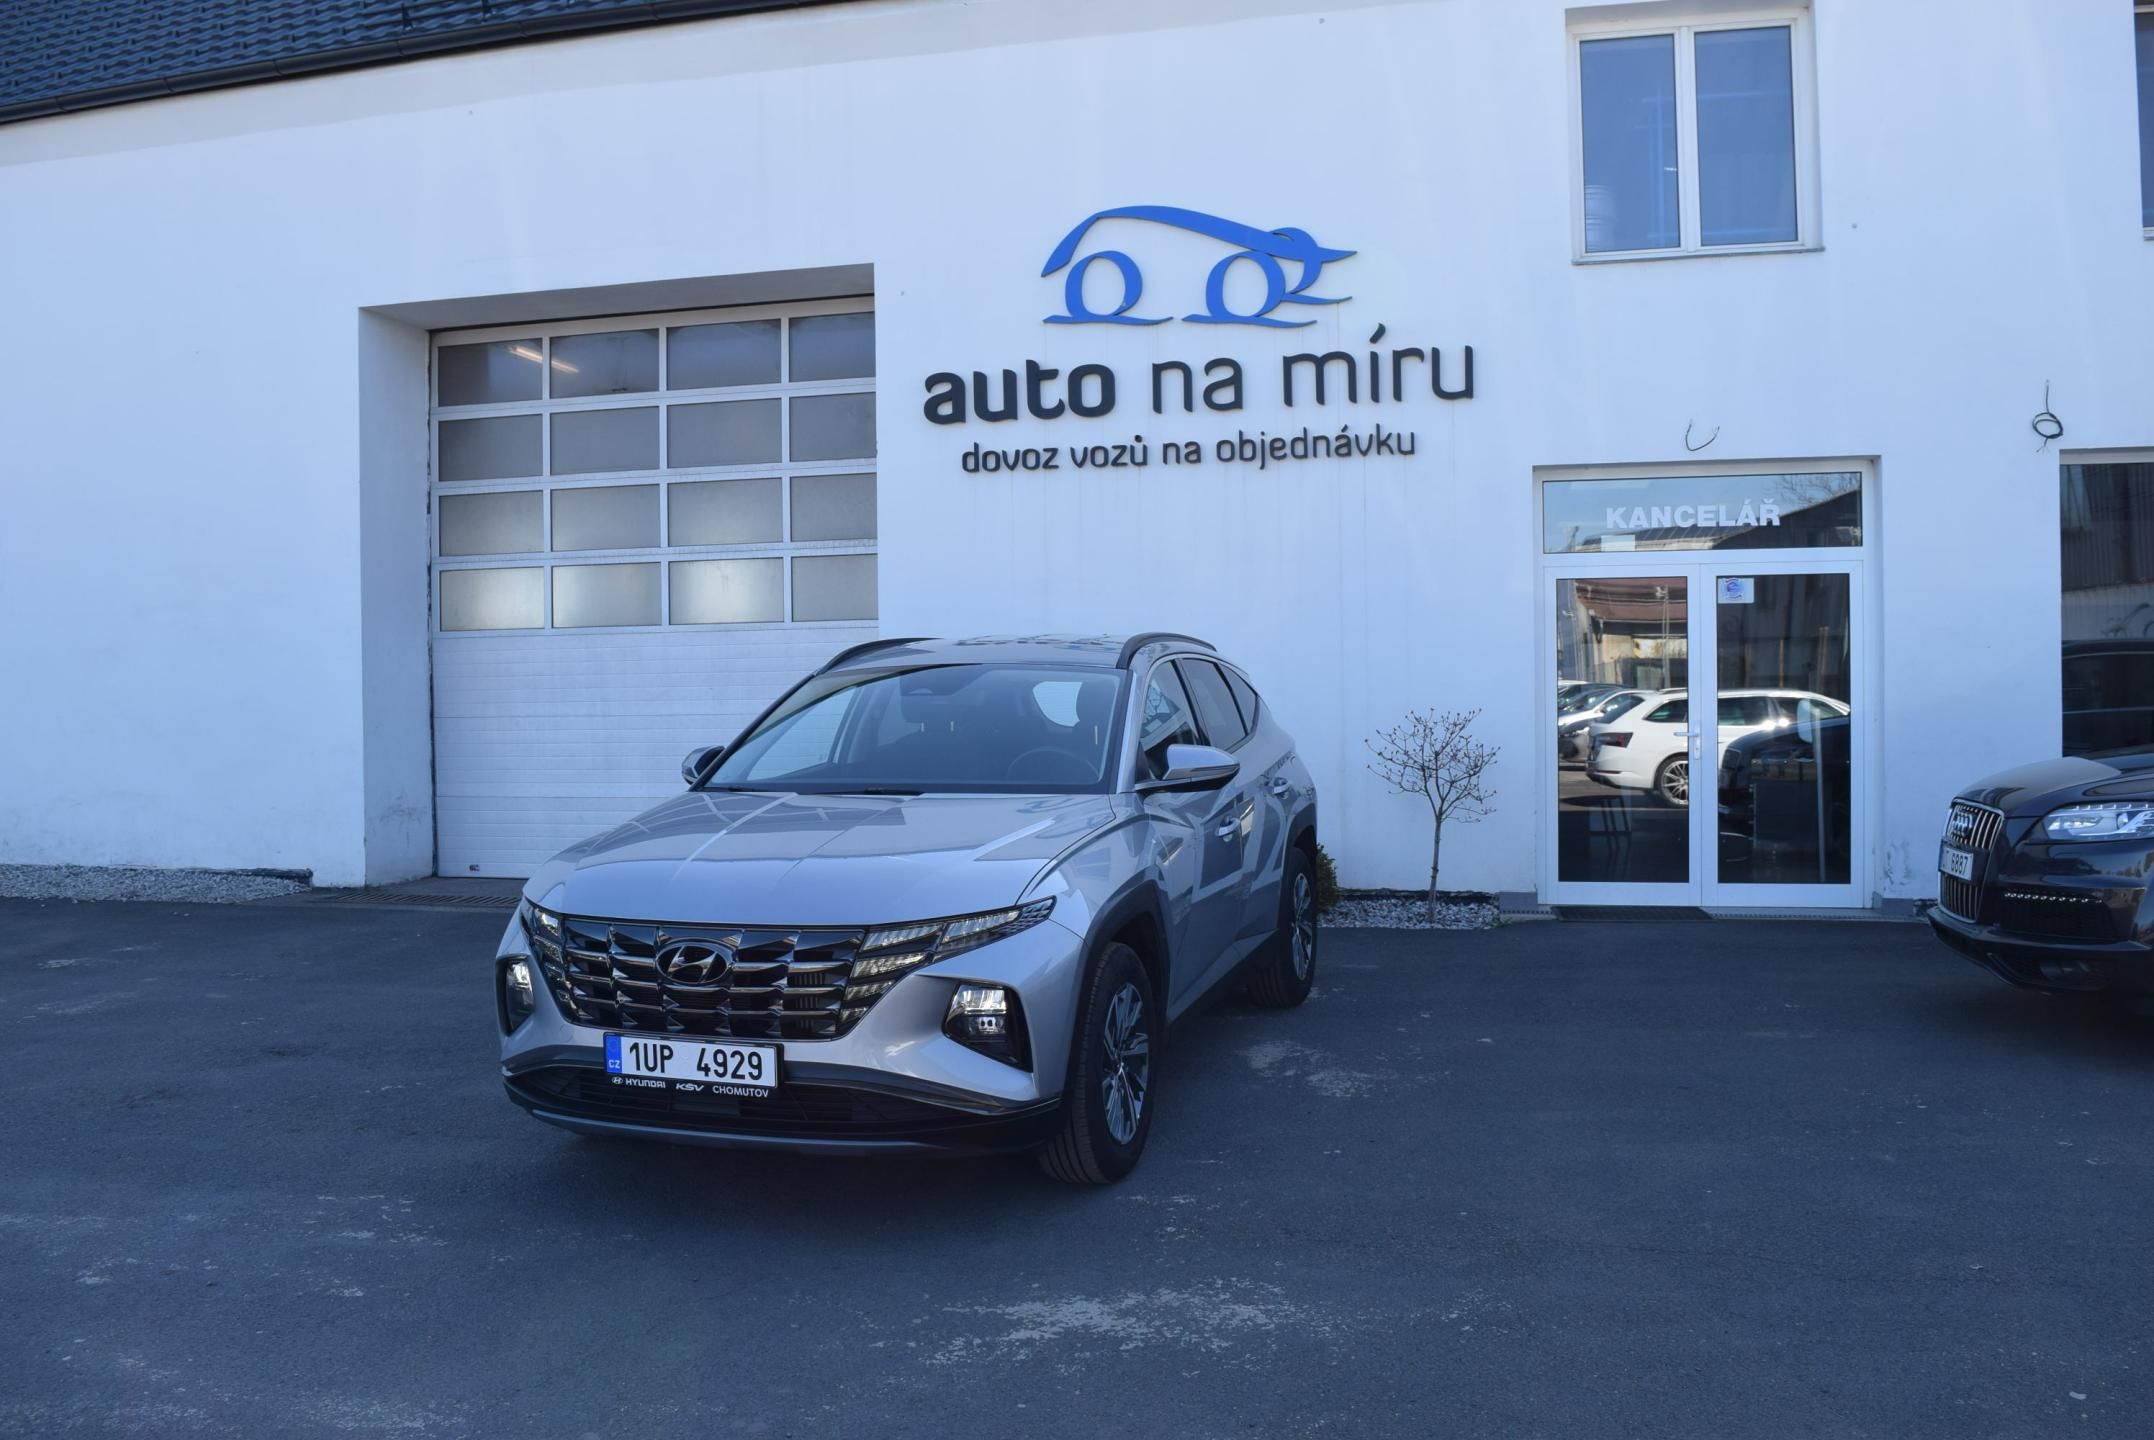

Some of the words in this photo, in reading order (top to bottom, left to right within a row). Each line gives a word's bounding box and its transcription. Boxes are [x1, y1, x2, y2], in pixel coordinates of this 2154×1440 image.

[924, 360, 1115, 425] auto
[1152, 358, 1243, 414] na
[1283, 324, 1474, 407] míru
[962, 442, 1059, 473] dovoz
[1070, 435, 1148, 468] vozů
[1163, 441, 1201, 464] na
[1216, 424, 1415, 470] objednávku
[1606, 499, 1780, 529] KANCELÁŘ
[609, 1060, 620, 1069] CZ
[630, 1043, 673, 1073] 1UP
[697, 1048, 762, 1080] 4929
[625, 1078, 666, 1089] HYUNDAI
[675, 1083, 704, 1092] KSV
[712, 1085, 769, 1098] CHOMUTOV
